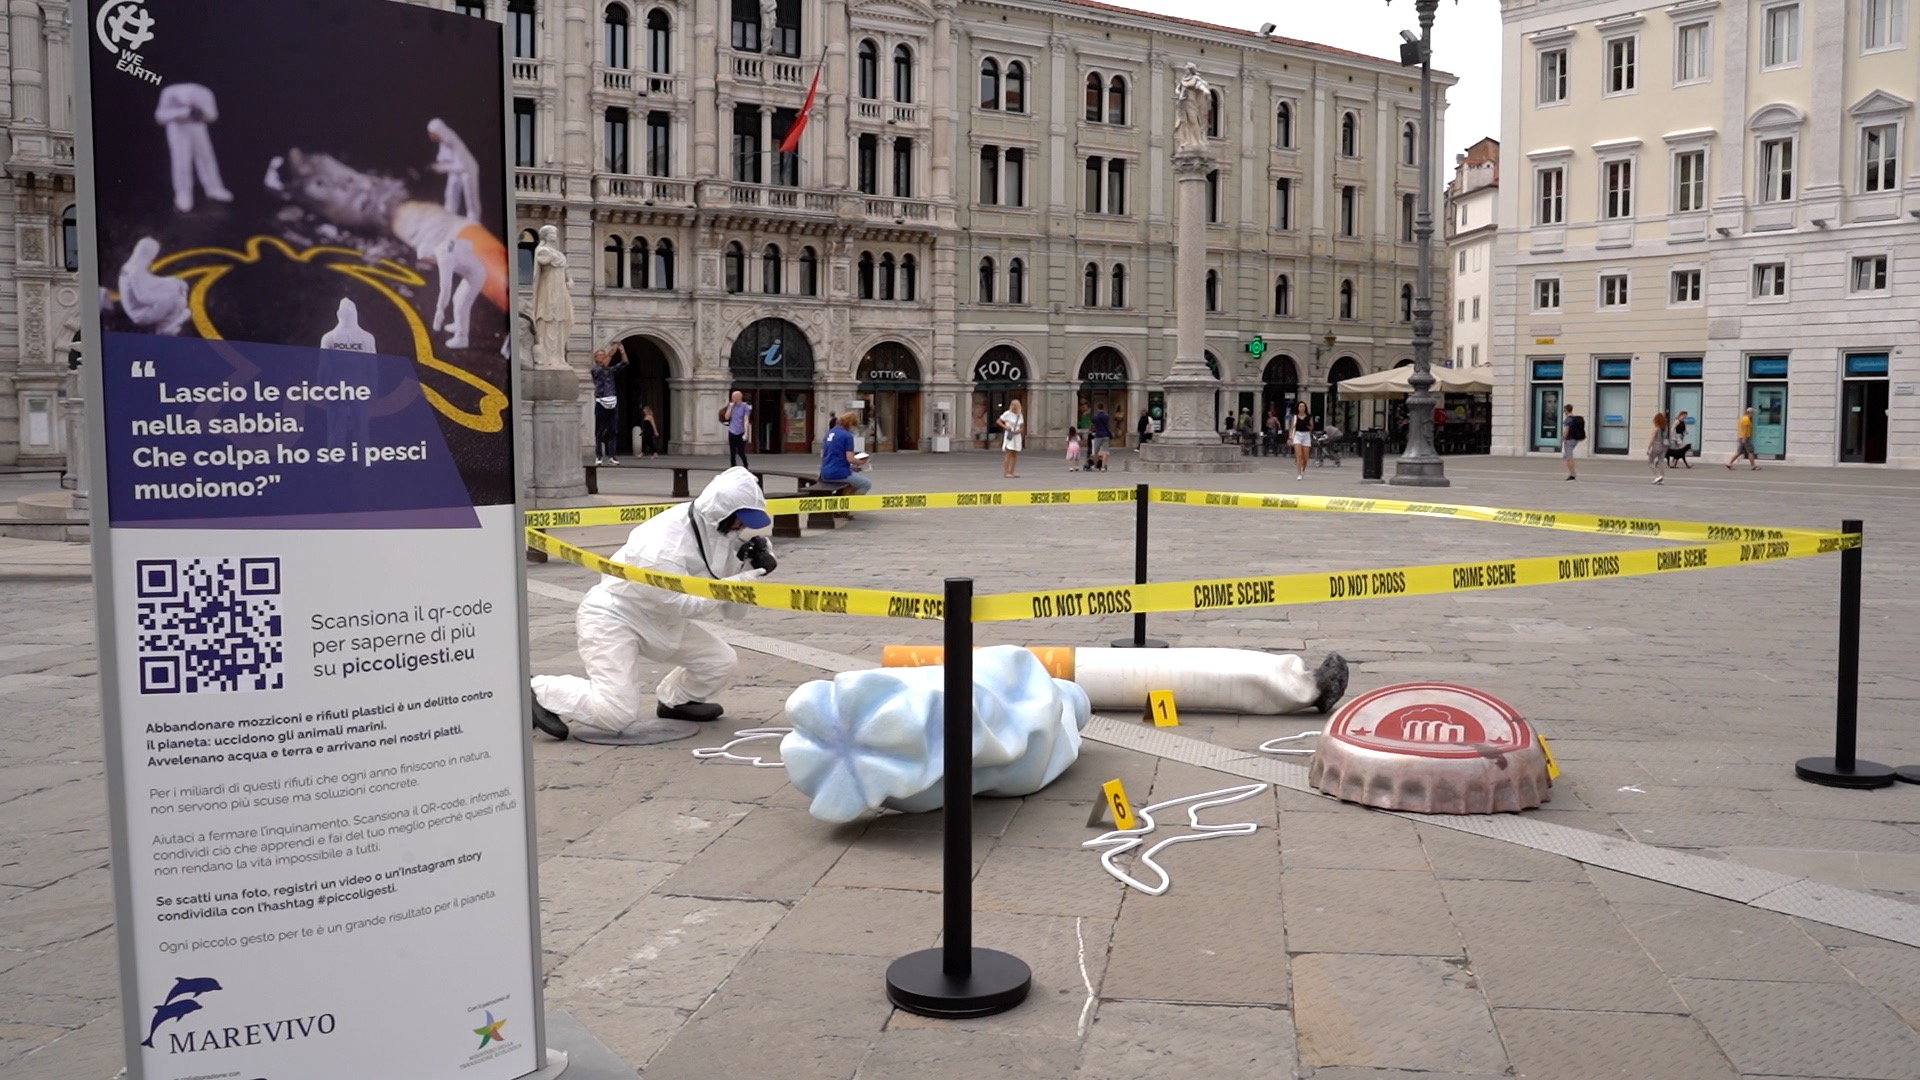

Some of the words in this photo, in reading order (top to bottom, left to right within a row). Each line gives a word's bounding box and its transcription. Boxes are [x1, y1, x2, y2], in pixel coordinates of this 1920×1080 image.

[122, 49, 144, 66] WE
[116, 60, 162, 85] EARTH
[870, 370, 907, 379] OTTICA
[978, 360, 1021, 380] FOTO
[1088, 372, 1120, 380] OTTICA
[159, 381, 247, 403] Lascio
[254, 381, 280, 401] le
[286, 380, 371, 401] cicche
[132, 414, 202, 435] nella
[208, 412, 304, 434] sabbia.
[132, 446, 187, 467] Che
[193, 444, 270, 470] colpa
[277, 443, 310, 464] ho
[316, 447, 346, 463] se
[351, 442, 358, 462] i
[364, 440, 426, 467] pesci
[1657, 550, 1682, 570] CRIME
[1684, 548, 1707, 567] SCENE
[1740, 545, 1751, 561] DO
[1453, 565, 1484, 588] CRIME
[1486, 563, 1516, 585] SCENE
[1559, 560, 1571, 579] DO
[1574, 558, 1590, 578] NOT
[1593, 556, 1620, 576] CROSS
[1194, 583, 1233, 608] CRIME
[1237, 581, 1275, 605] SCENE
[1330, 575, 1344, 597] DO
[1349, 574, 1368, 596] NOT
[1372, 571, 1406, 594] CROSS
[311, 609, 409, 630] Scansiona
[414, 605, 424, 621] il
[428, 599, 492, 623] qr-code
[888, 596, 920, 617] CRIME
[1033, 596, 1051, 618] DO
[1056, 593, 1083, 616] NOT
[1088, 590, 1132, 614] CROSS
[312, 639, 346, 658] per
[351, 631, 426, 652] saperne
[430, 625, 446, 642] di
[451, 622, 475, 644] più
[313, 664, 336, 677] su
[342, 647, 474, 678] piccoligesti.eu
[145, 720, 235, 733] Abbandonare
[238, 712, 302, 728] mozziconi
[305, 714, 313, 722] e
[316, 708, 348, 721] rifiuti
[351, 703, 395, 720] plastici
[397, 702, 404, 712] è
[407, 702, 421, 711] un
[423, 696, 459, 708] delitto
[461, 691, 493, 703] contro
[1158, 700, 1168, 720] 1
[146, 739, 155, 750] il
[157, 737, 211, 752] pianeta:
[214, 733, 275, 746] uccidono
[277, 730, 294, 744] gli
[297, 725, 343, 739] animali
[346, 720, 386, 734] marini.
[147, 754, 224, 767] Avvelenano
[227, 751, 268, 762] acqua
[270, 750, 279, 758] e
[281, 746, 313, 757] terra
[316, 745, 324, 754] e
[326, 739, 376, 753] arrivano
[379, 734, 397, 746] nei
[399, 729, 431, 743] nostri
[433, 724, 463, 740] piatti.
[149, 788, 171, 799] Per
[179, 783, 225, 797] miliardi
[228, 782, 240, 794] di
[242, 779, 281, 794] questi
[284, 775, 313, 788] rifiuti
[315, 774, 338, 785] che
[341, 772, 366, 784] ogni
[369, 767, 398, 778] anno
[400, 759, 446, 774] finiscono
[448, 757, 457, 765] in
[150, 804, 174, 815] non
[177, 801, 228, 813] servono
[230, 797, 250, 811] più
[253, 795, 290, 807] scuse
[292, 793, 312, 803] ma
[314, 786, 366, 801] soluzioni
[1114, 794, 1126, 819] 6
[151, 832, 195, 846] Aiutaci
[197, 833, 206, 842] a
[208, 829, 258, 841] fermare
[353, 809, 410, 826] Scansiona
[412, 806, 419, 815] il
[152, 846, 209, 861] condividi
[211, 844, 231, 857] ciò
[233, 843, 258, 854] che
[260, 835, 314, 853] apprendi
[317, 836, 326, 845] e
[328, 833, 342, 844] fai
[345, 829, 364, 841] del
[366, 828, 386, 838] tuo
[388, 821, 426, 834] meglio
[427, 813, 463, 829] perché
[464, 806, 493, 821] questi
[495, 800, 516, 812] rifiuti
[154, 866, 178, 876] non
[181, 861, 233, 874] rendano
[236, 859, 248, 870] la
[249, 857, 272, 868] vita
[275, 848, 343, 866] impossibile
[346, 848, 353, 856] a
[156, 896, 172, 907] Se
[175, 892, 211, 905] scatti
[214, 892, 238, 902] una
[273, 880, 318, 897] registri
[320, 880, 336, 890] un
[338, 875, 372, 887] video
[374, 873, 382, 881] o
[457, 852, 482, 864] story
[157, 907, 228, 922] condividila
[230, 905, 254, 915] con
[257, 898, 314, 912] l'hashtag
[158, 939, 188, 954] Ogni
[191, 936, 237, 952] piccolo
[239, 932, 275, 947] gesto
[278, 930, 299, 942] per
[301, 927, 314, 937] te
[316, 926, 324, 935] è
[327, 923, 342, 934] un
[345, 915, 386, 933] grande
[388, 906, 432, 922] risultato
[434, 901, 450, 915] per
[170, 1014, 335, 1054] MAREVIVO
